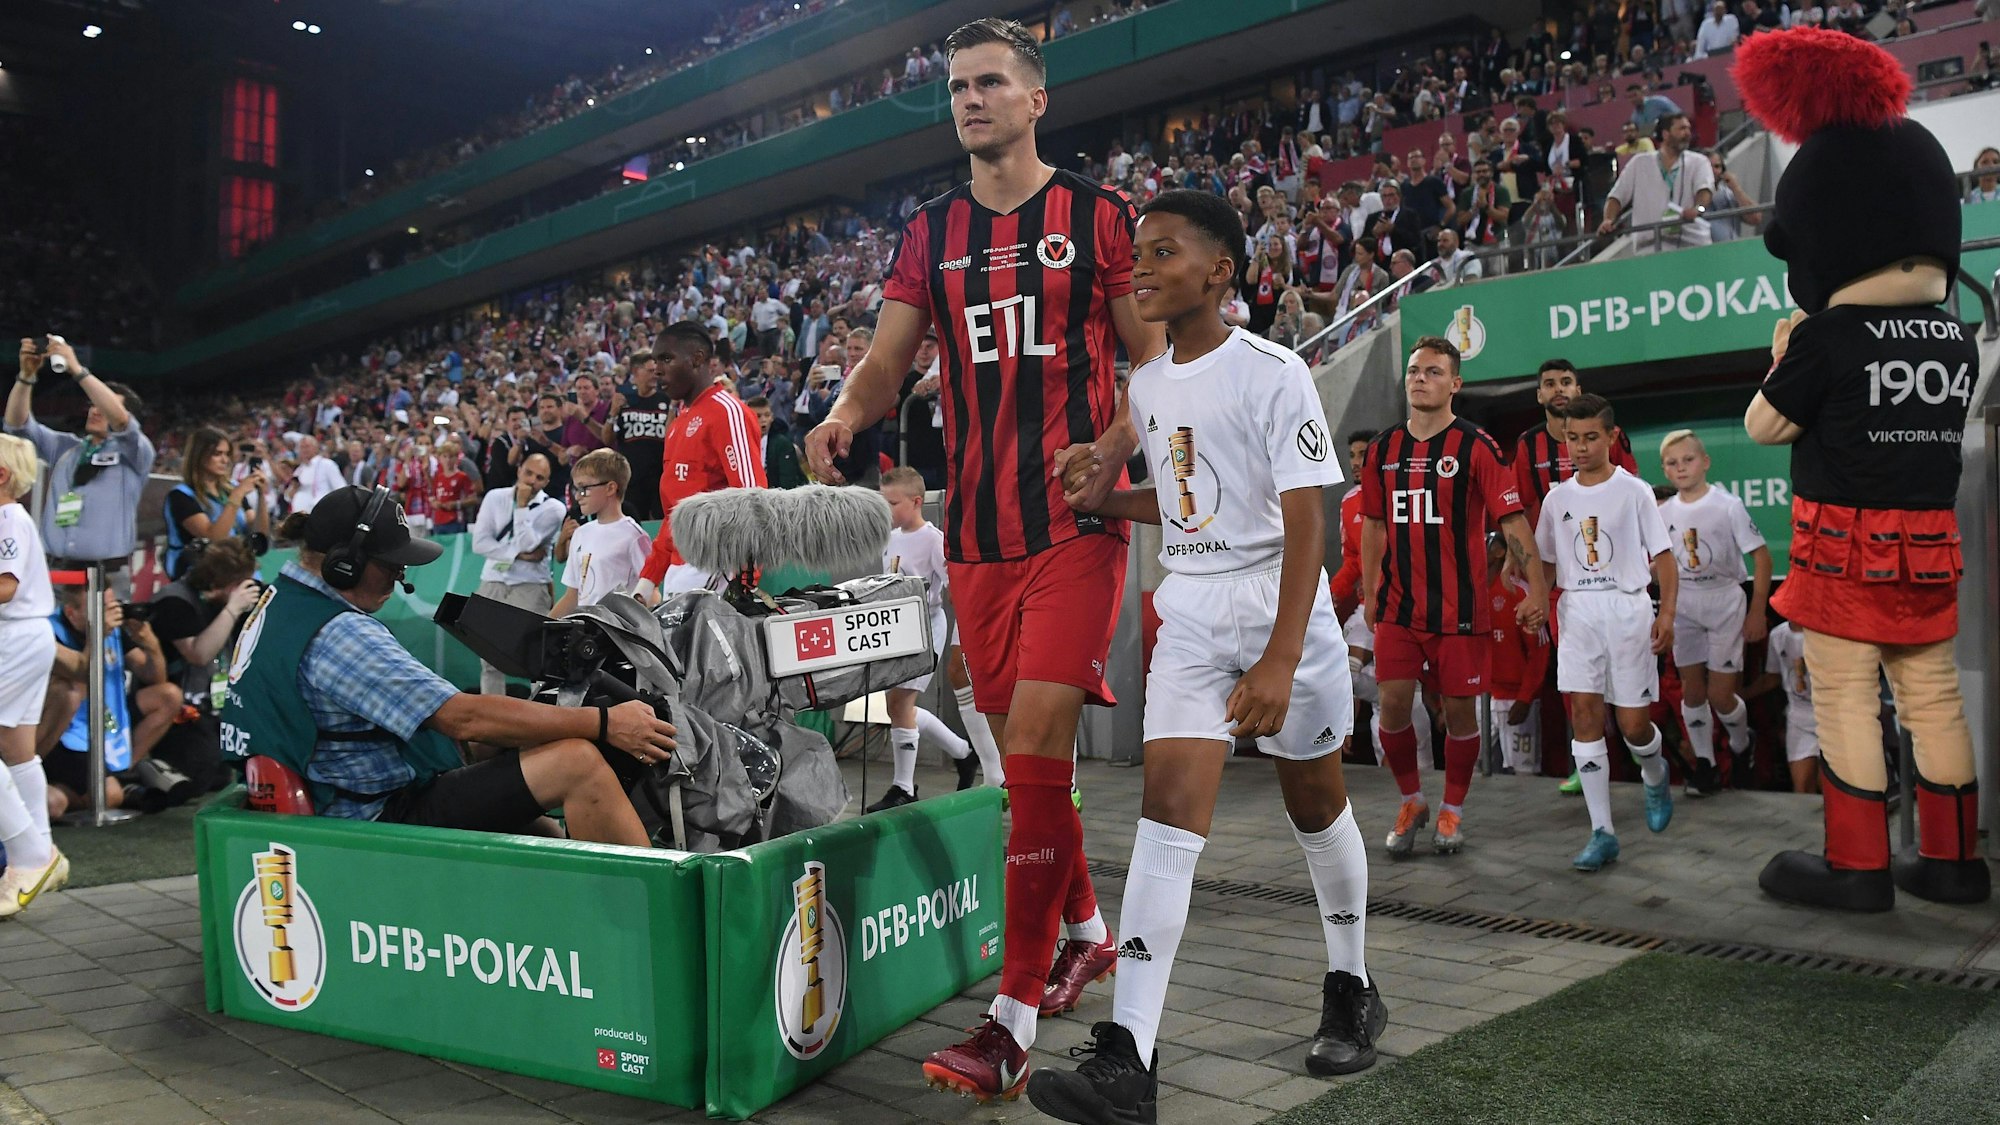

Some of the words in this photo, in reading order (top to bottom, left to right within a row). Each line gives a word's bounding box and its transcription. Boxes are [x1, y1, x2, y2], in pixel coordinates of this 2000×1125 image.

[938, 255, 972, 270] capelli
[964, 294, 1057, 364] ETL
[1864, 319, 1964, 341] VIKTOR
[1864, 360, 1971, 407] 1904
[623, 421, 666, 439] 2020
[1868, 430, 1938, 443] VIKTORIA
[1392, 488, 1444, 524] ETL
[845, 608, 901, 631] SPORT
[847, 631, 891, 652] CAST
[861, 873, 980, 962] DFB-POKAL
[350, 920, 594, 999] DFB-POKAL
[594, 1027, 634, 1041] produced
[635, 1031, 648, 1046] by
[620, 1051, 650, 1066] SPORT
[621, 1062, 645, 1075] CAST
